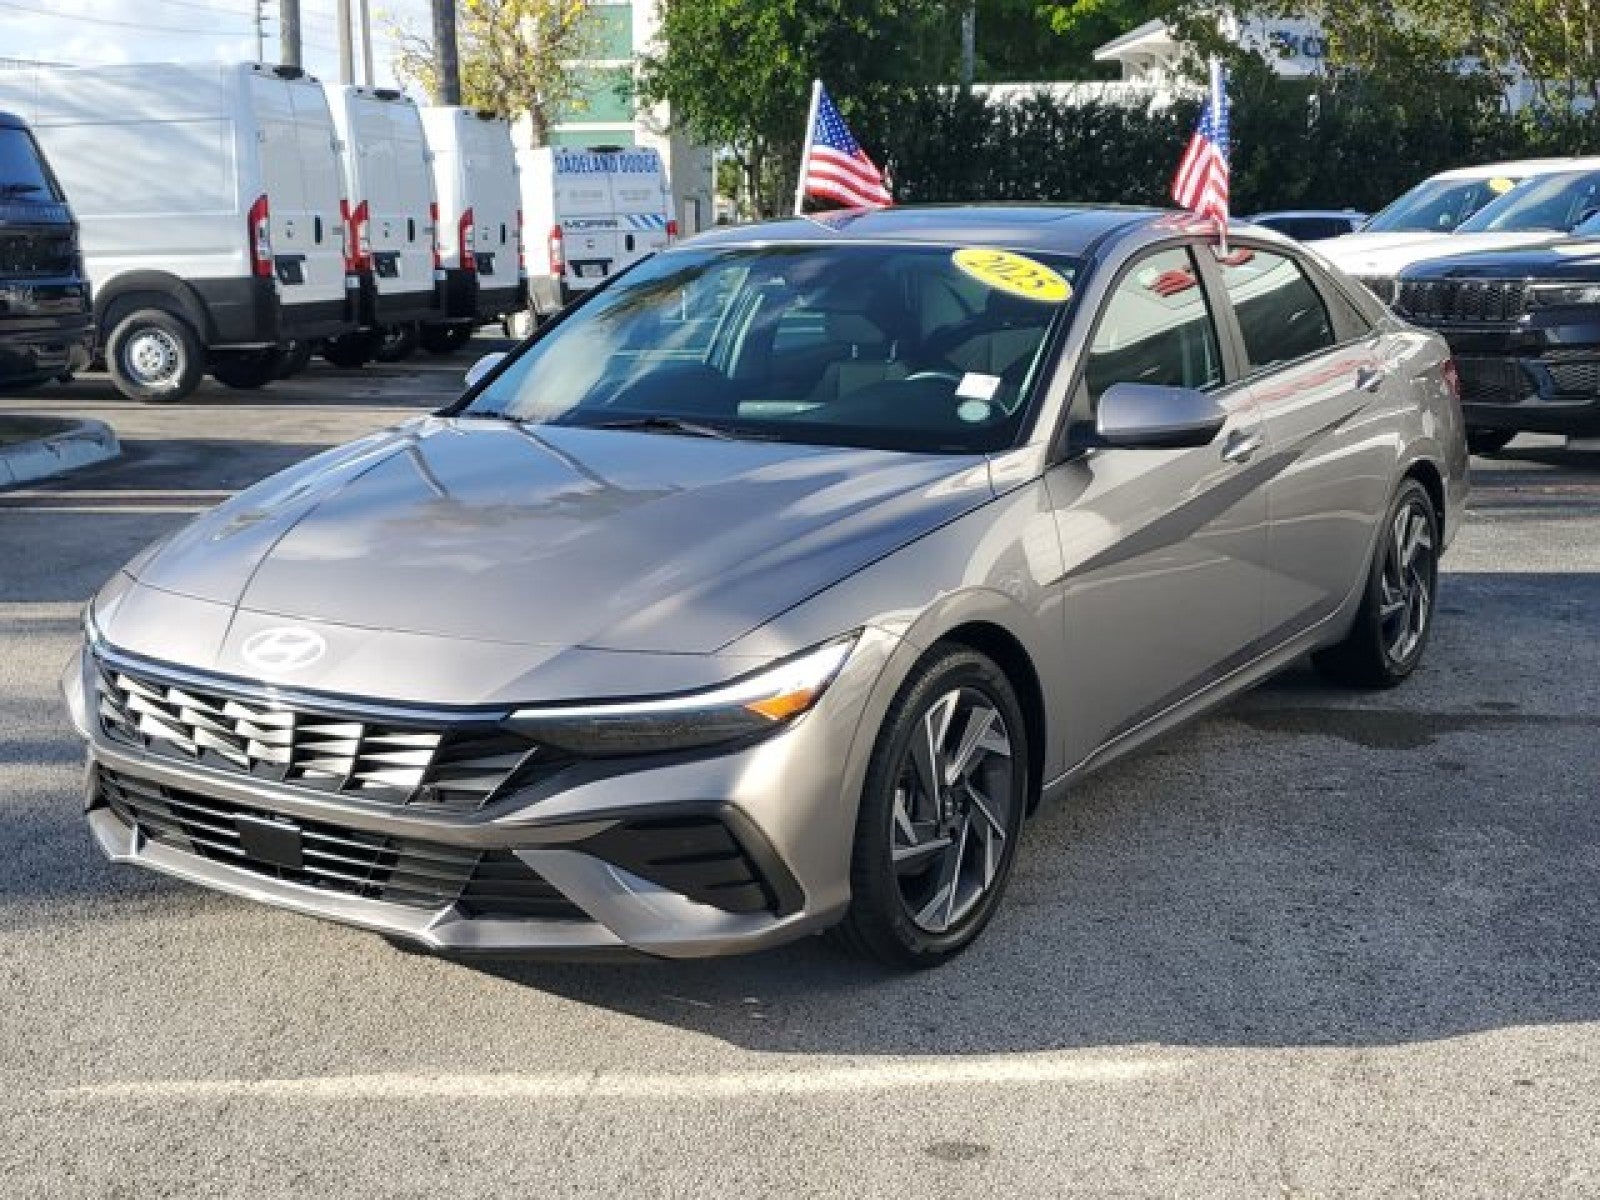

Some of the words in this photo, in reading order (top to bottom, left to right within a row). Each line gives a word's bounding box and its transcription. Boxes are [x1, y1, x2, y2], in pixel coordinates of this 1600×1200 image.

[554, 155, 618, 174] DADELAND
[619, 154, 659, 173] DODGE
[564, 219, 618, 229] MOPAR
[964, 253, 1059, 291] 2025
